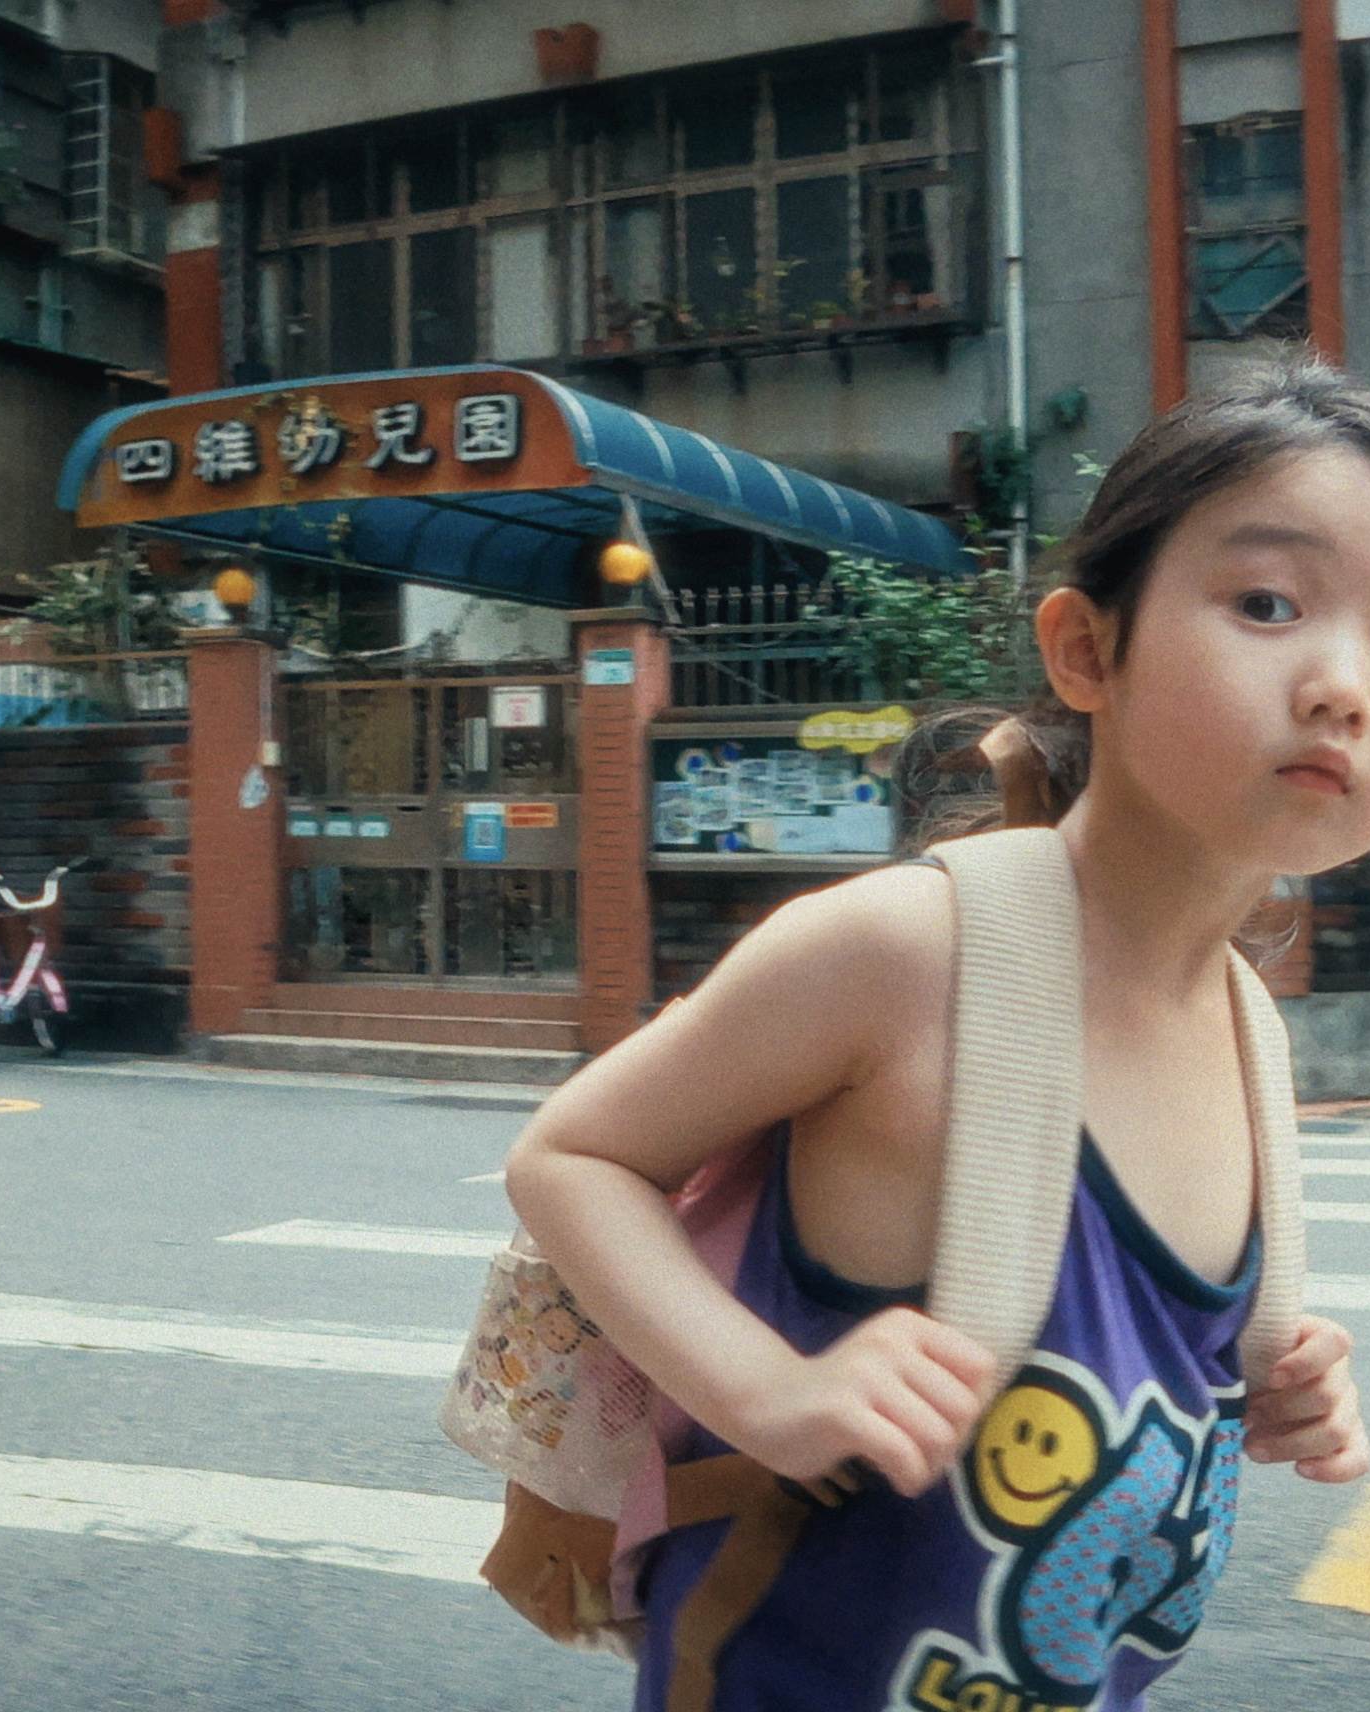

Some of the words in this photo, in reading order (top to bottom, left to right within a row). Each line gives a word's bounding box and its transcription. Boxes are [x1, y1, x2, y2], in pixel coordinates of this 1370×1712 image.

[116, 394, 520, 482] 四維幼兒園
